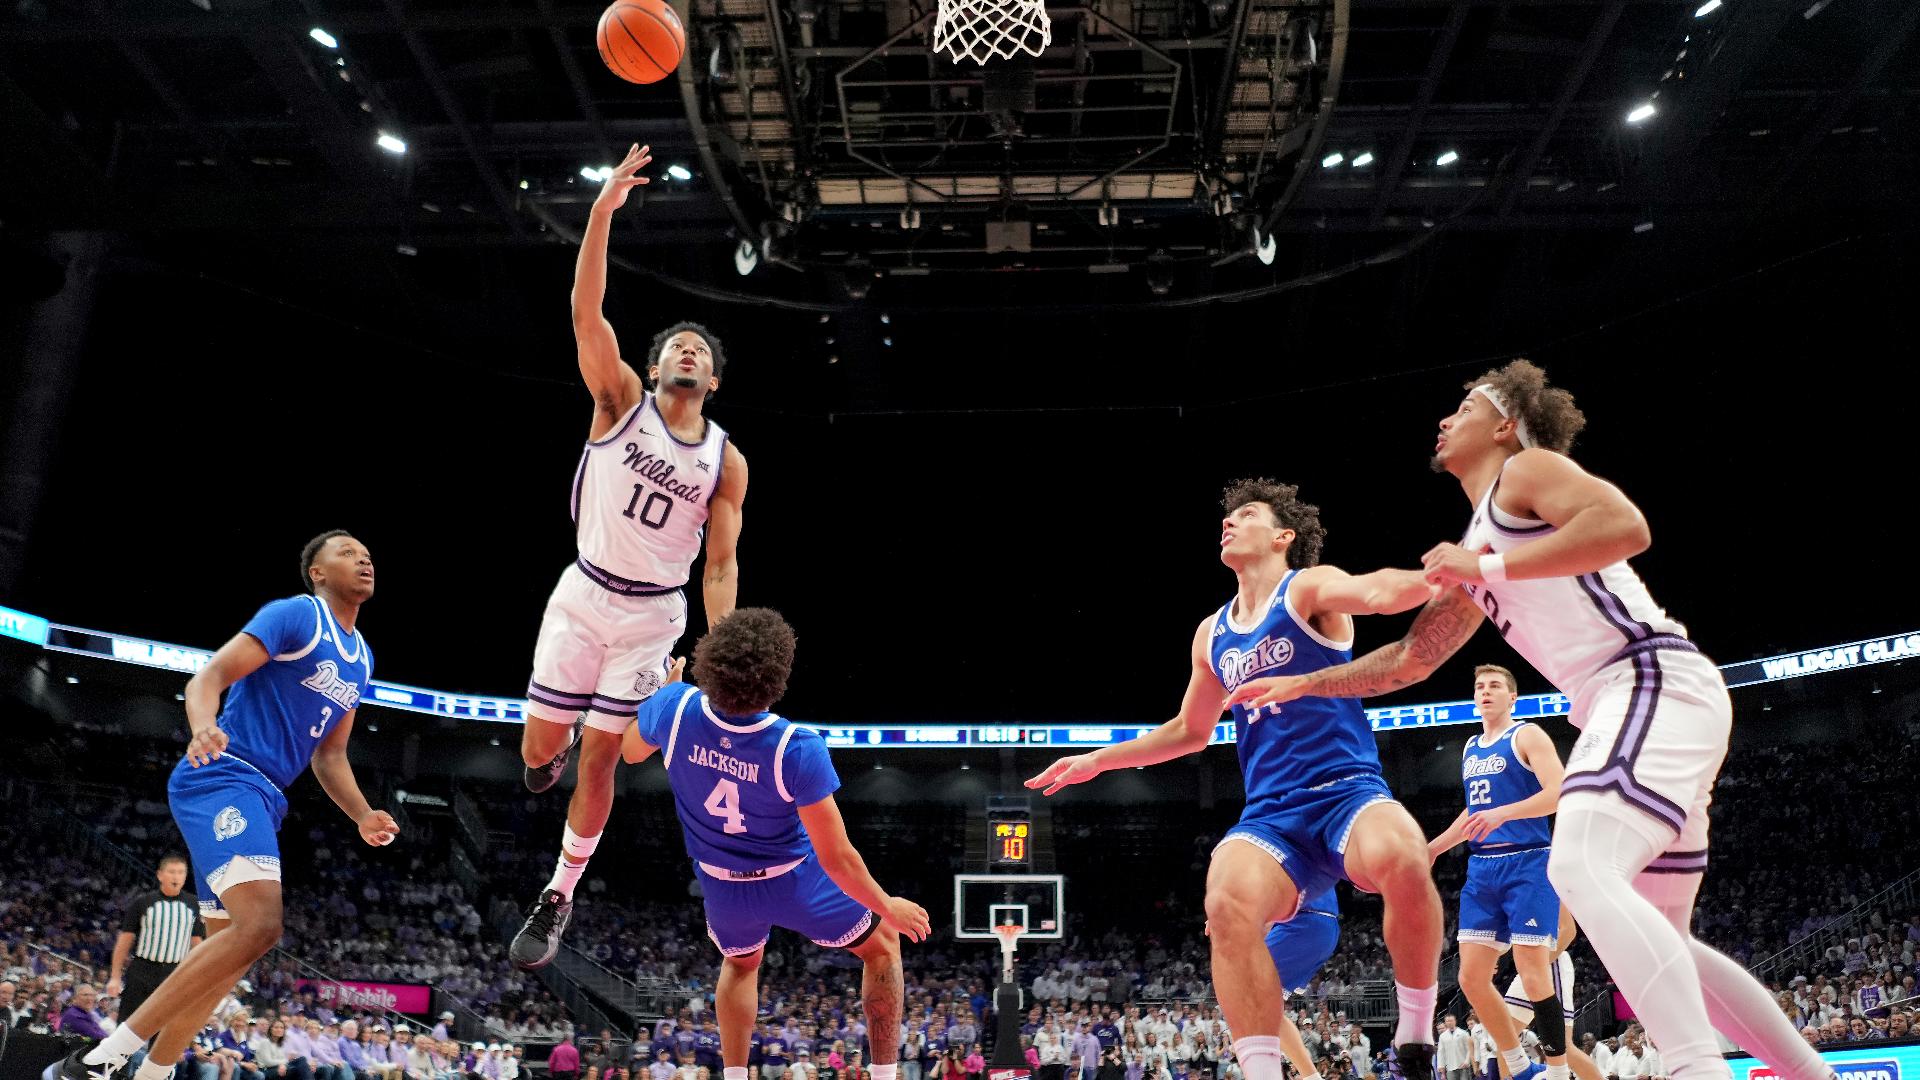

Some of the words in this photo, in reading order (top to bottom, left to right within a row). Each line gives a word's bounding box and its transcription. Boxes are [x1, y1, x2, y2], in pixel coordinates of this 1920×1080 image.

[621, 442, 703, 504] Wildcats
[622, 483, 674, 531] 10
[1219, 634, 1294, 692] Drake
[1762, 645, 1861, 680] WILDCAT
[1863, 634, 1920, 663] CLAS
[300, 660, 360, 712] Drake
[309, 705, 332, 739] 3
[688, 744, 760, 784] JACKSON
[1463, 752, 1507, 779] Drake
[703, 777, 748, 835] 4
[1468, 779, 1492, 806] 22
[1004, 838, 1024, 860] 10
[339, 986, 398, 1008] Mobile
